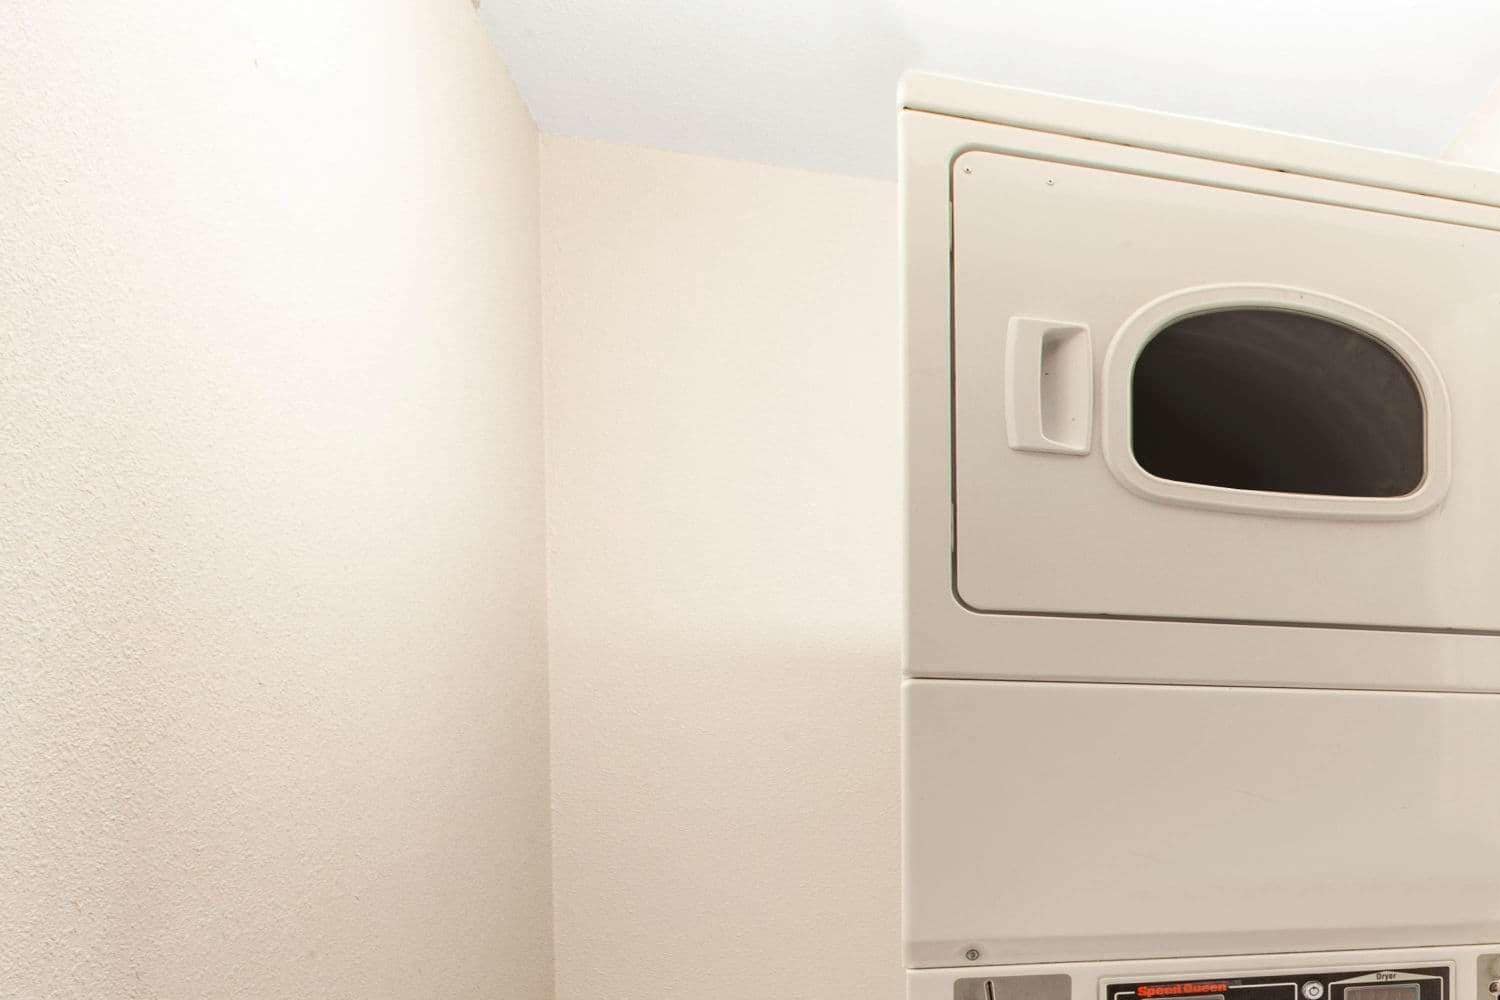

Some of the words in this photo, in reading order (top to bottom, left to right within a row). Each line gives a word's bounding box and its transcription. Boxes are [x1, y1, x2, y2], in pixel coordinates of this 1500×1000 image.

[1376, 972, 1397, 981] Dryer
[1137, 984, 1182, 997] Speed
[1183, 983, 1228, 993] Queen
